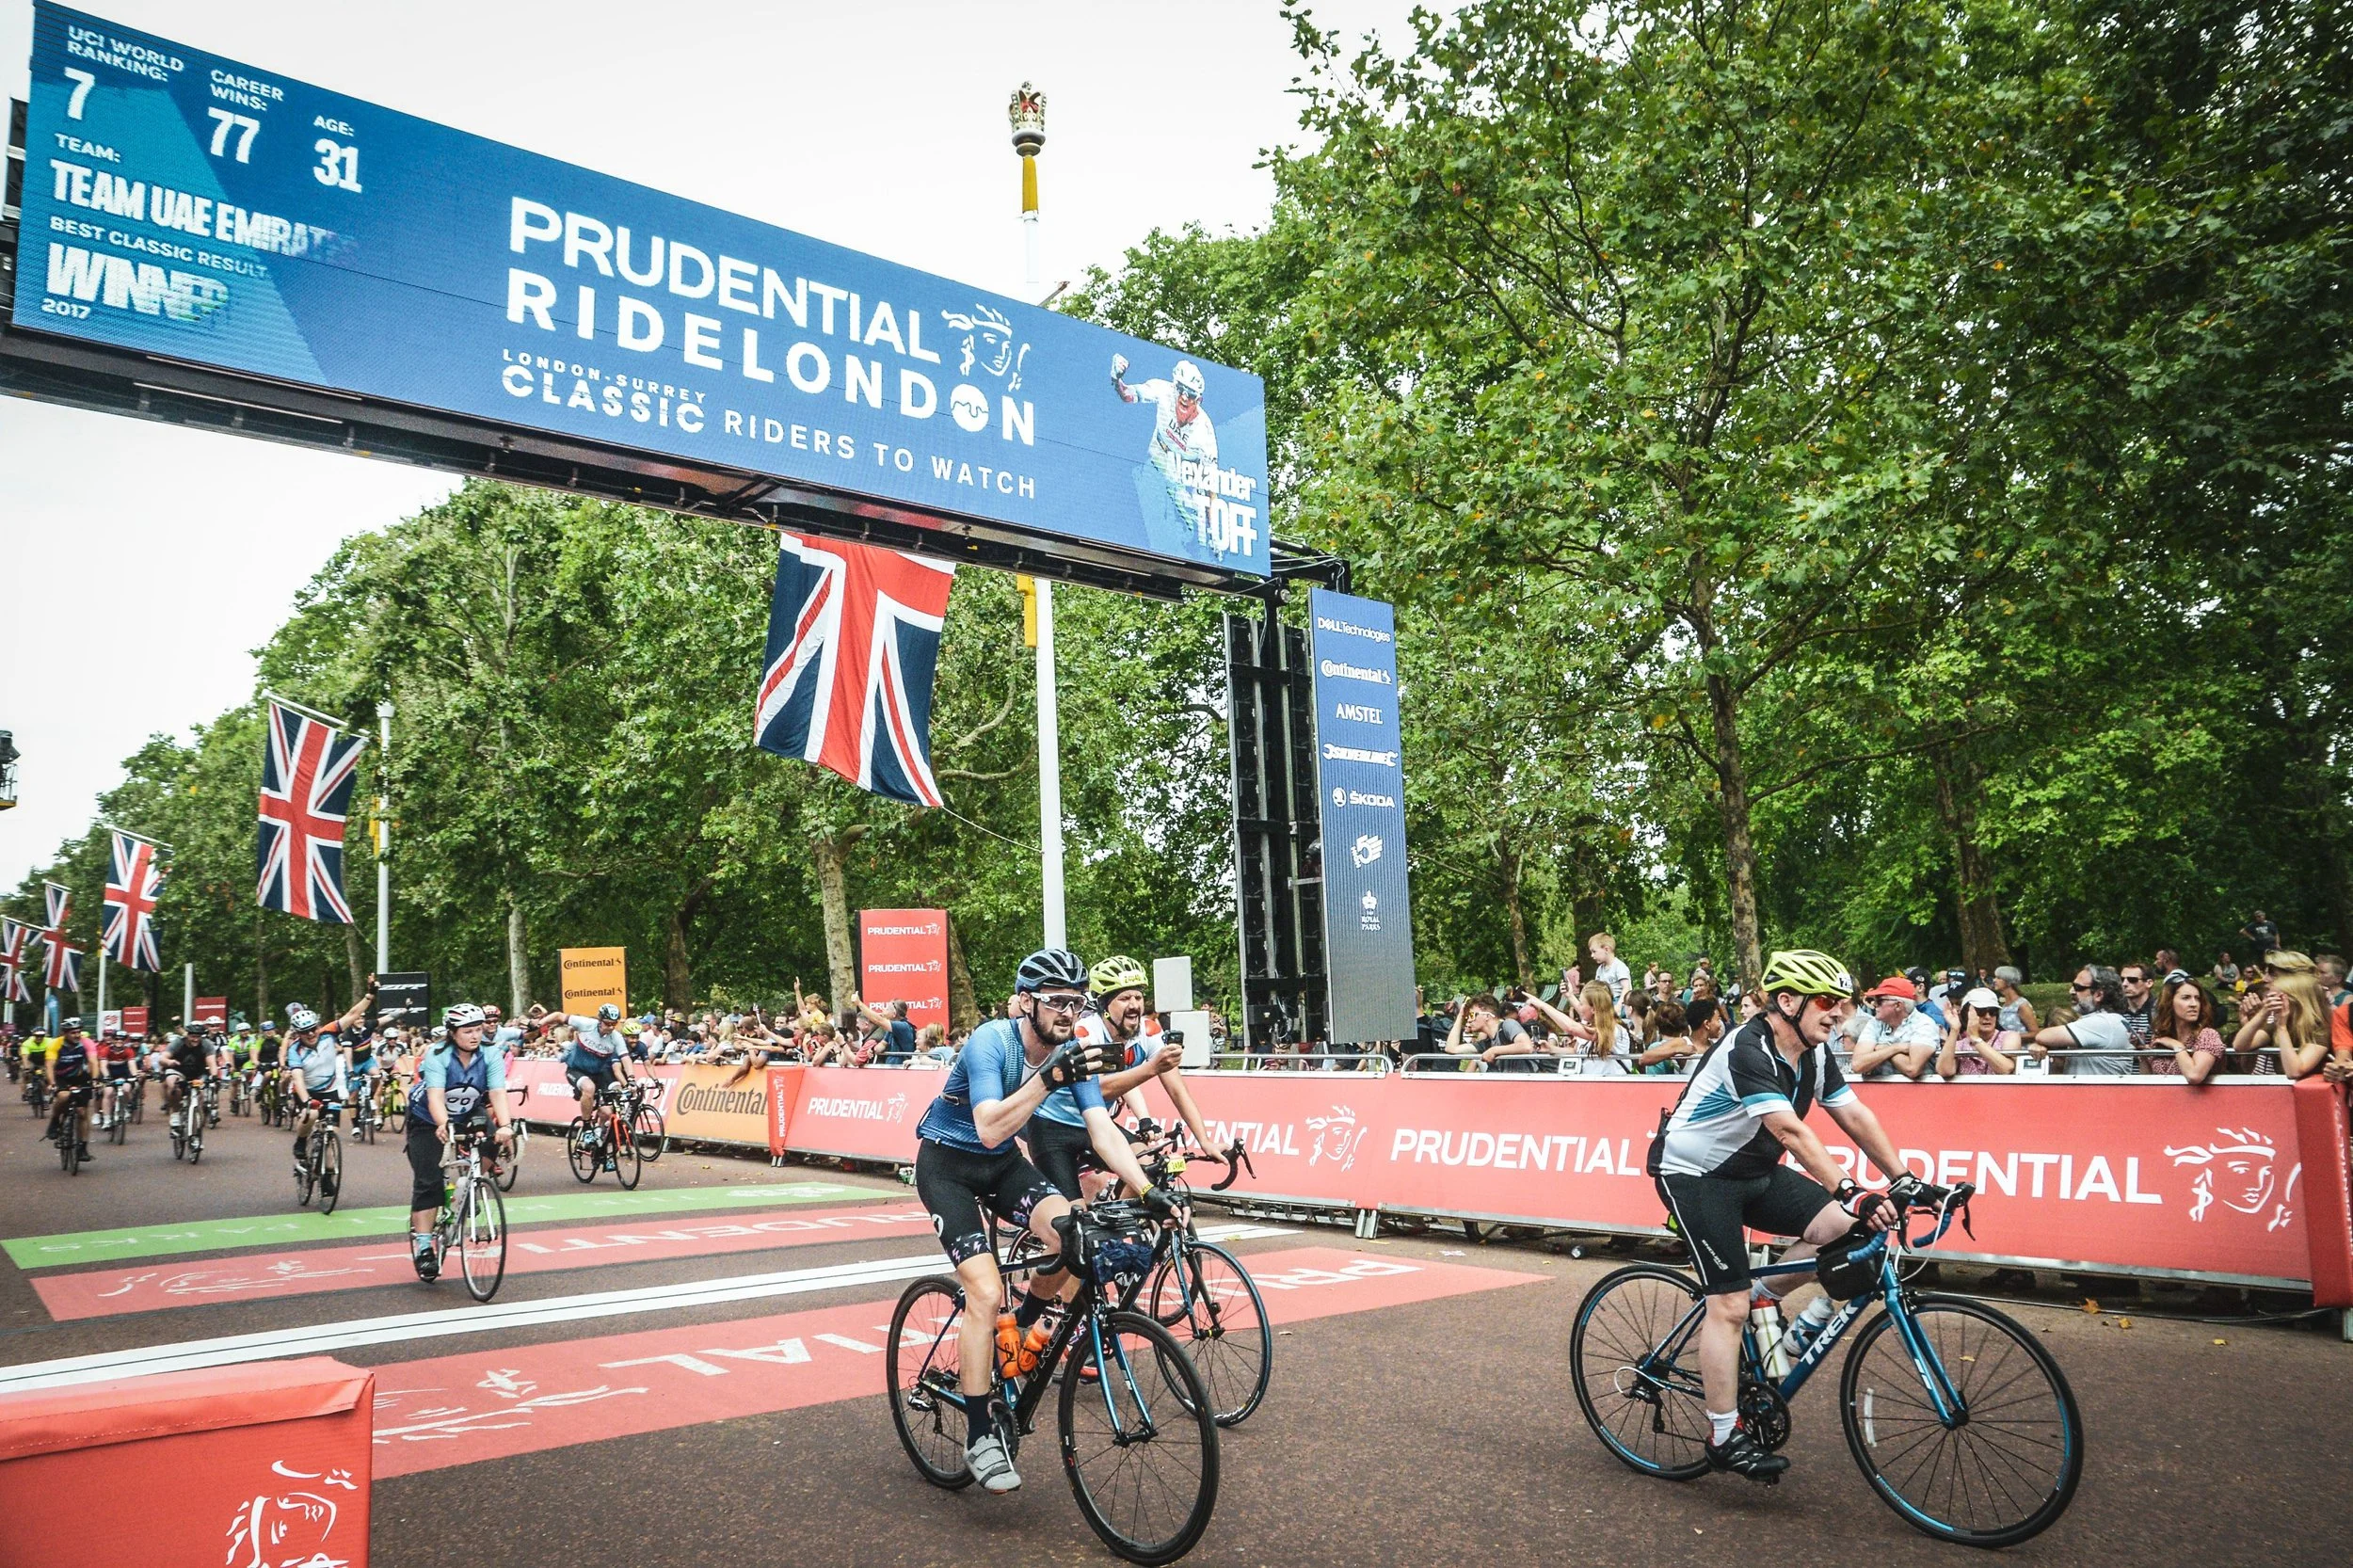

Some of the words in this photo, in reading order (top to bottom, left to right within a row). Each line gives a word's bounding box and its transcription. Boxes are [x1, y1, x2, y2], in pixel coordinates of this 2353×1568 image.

[67, 40, 168, 82] RANKING:
[69, 24, 105, 48] UCI
[109, 37, 184, 72] WORLD
[64, 66, 95, 120] 7
[209, 83, 268, 111] WINS:
[210, 69, 284, 102] CAREER
[207, 106, 261, 164] 77
[312, 114, 355, 137] AGE:
[55, 133, 121, 164] TEAM:
[312, 137, 363, 194] 31
[50, 159, 146, 221] TEAM
[150, 184, 214, 238] UAE
[49, 216, 106, 243] BEST
[108, 231, 194, 264] CLASSIC
[509, 196, 941, 364] PRUDENTIAL
[40, 297, 92, 321] 2017
[506, 267, 1036, 446] RIDELONDON
[503, 348, 706, 404] LONDON-SURREY
[501, 364, 705, 434] CLASSIC
[724, 408, 856, 461] RIDERS
[873, 442, 915, 472] TO
[931, 457, 1036, 500] WATCH
[1341, 621, 1391, 643] Technologies
[1321, 659, 1383, 683] Continental
[1336, 702, 1384, 725] AMSTEL
[868, 926, 927, 936] PRUDENTIAL
[563, 958, 615, 970] Continental
[868, 963, 927, 973] PRUDENTIAL
[564, 987, 616, 1000] Continental
[869, 1000, 928, 1011] PRUTIAL
[807, 1096, 884, 1120] PRUDENTIAL
[1390, 1128, 1641, 1177] PRUDENTIAL
[1801, 1303, 1859, 1366] TREK
